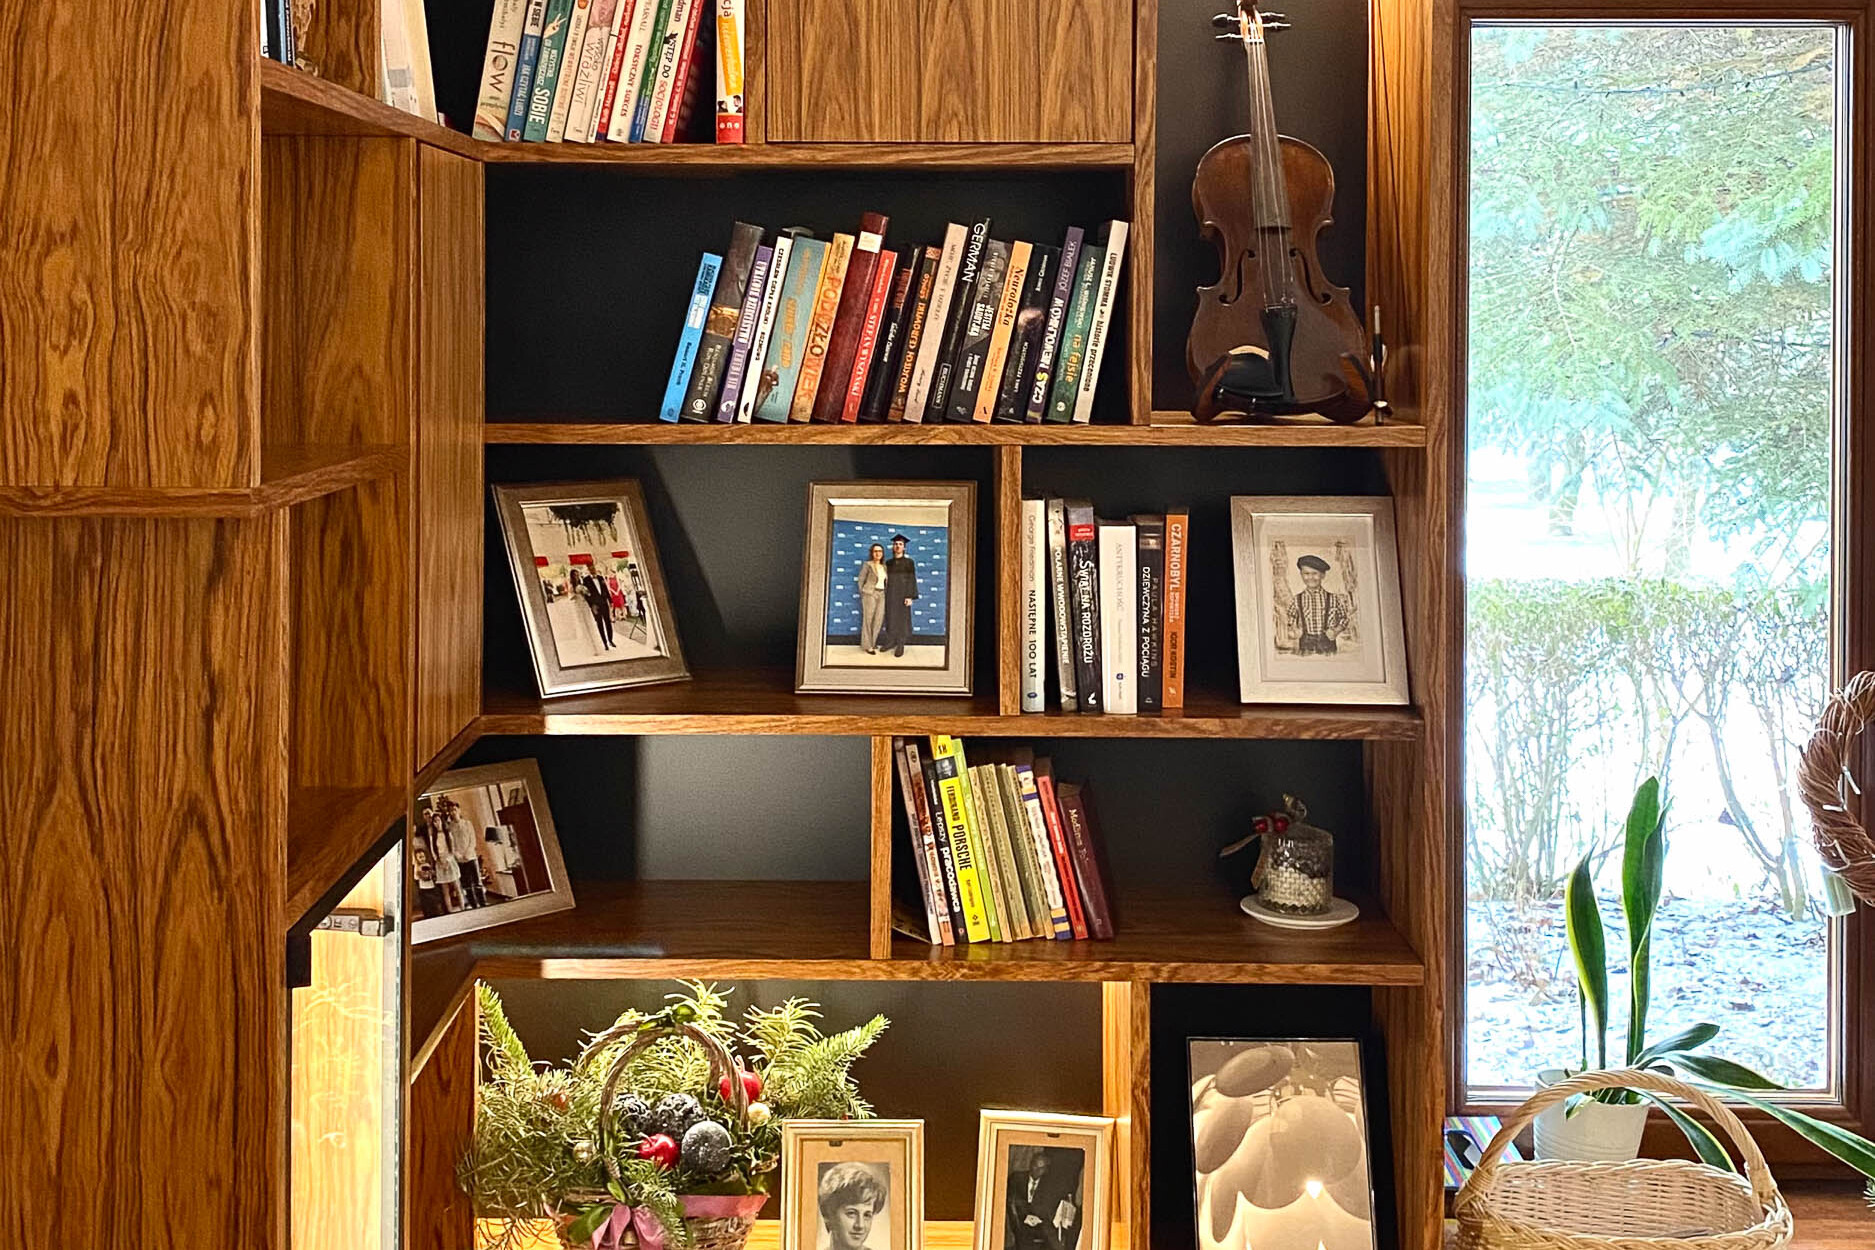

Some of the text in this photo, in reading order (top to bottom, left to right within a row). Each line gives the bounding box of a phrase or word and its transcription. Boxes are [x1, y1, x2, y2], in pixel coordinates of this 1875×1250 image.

[485, 39, 516, 93] flow
[621, 43, 641, 117] TOKSYCZNY SUKCES
[662, 64, 670, 78] DO
[529, 87, 550, 124] SOBIE
[650, 80, 667, 130] SOCJOLOGII
[962, 221, 987, 282] GERMAN
[1058, 267, 1071, 291] JÓZEF
[1100, 252, 1117, 307] LUDWIK STOMMA
[981, 304, 995, 331] JESTEM
[1072, 333, 1083, 348] na
[1032, 296, 1065, 403] CZAS NIEWOLNIKÓW
[1064, 351, 1081, 383] fejsie
[1055, 546, 1064, 581] POLARNE
[1170, 523, 1181, 590] CZARNOBYL
[1028, 589, 1036, 634] NASTĘPNE
[1081, 594, 1088, 609] NA
[1142, 566, 1150, 624] DZIEWCZYNA
[1140, 636, 1149, 677] POCIĄGU
[1150, 617, 1158, 667] HAWKINS
[952, 823, 972, 870] PORSCHE
[941, 846, 961, 912] pracodawca
